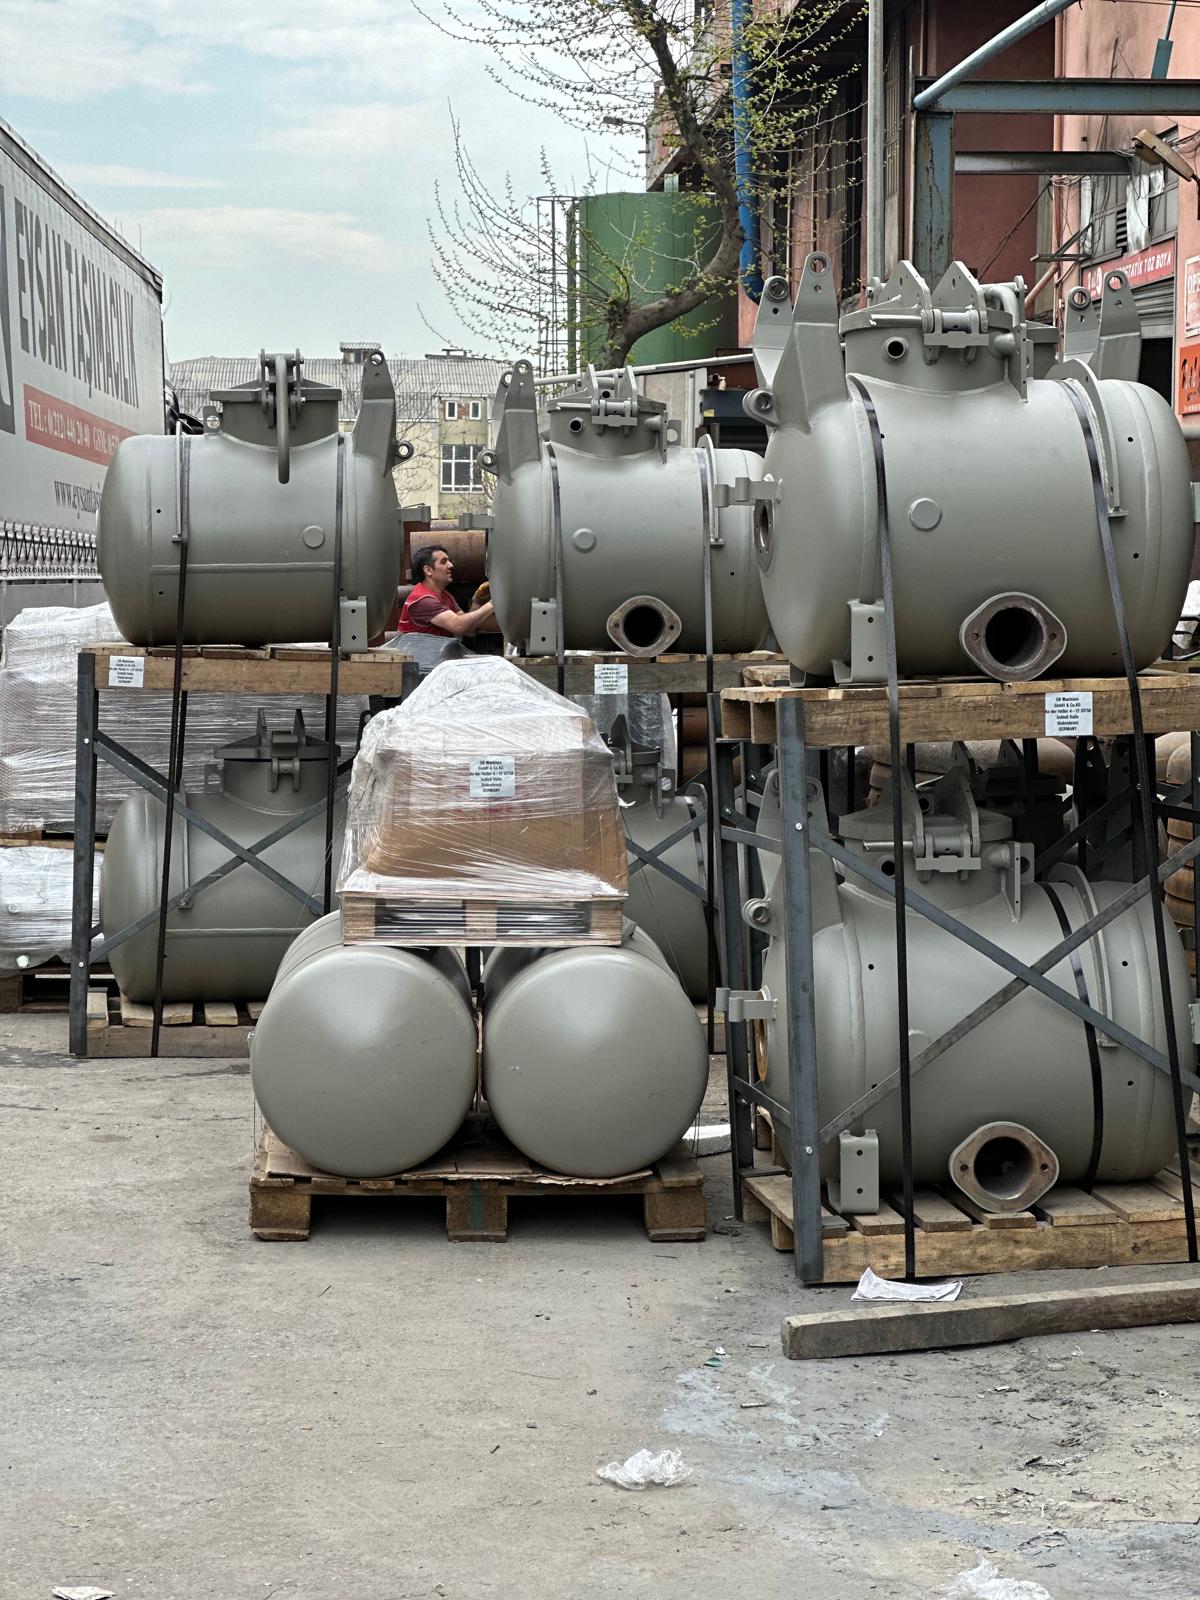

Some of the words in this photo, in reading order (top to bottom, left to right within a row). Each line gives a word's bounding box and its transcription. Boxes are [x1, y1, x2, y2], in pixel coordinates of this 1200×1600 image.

[14, 197, 68, 373] EYSAN
[64, 239, 140, 409] TAŞIMACILIK
[1144, 255, 1155, 273] TOZ
[1155, 251, 1171, 270] BOYA
